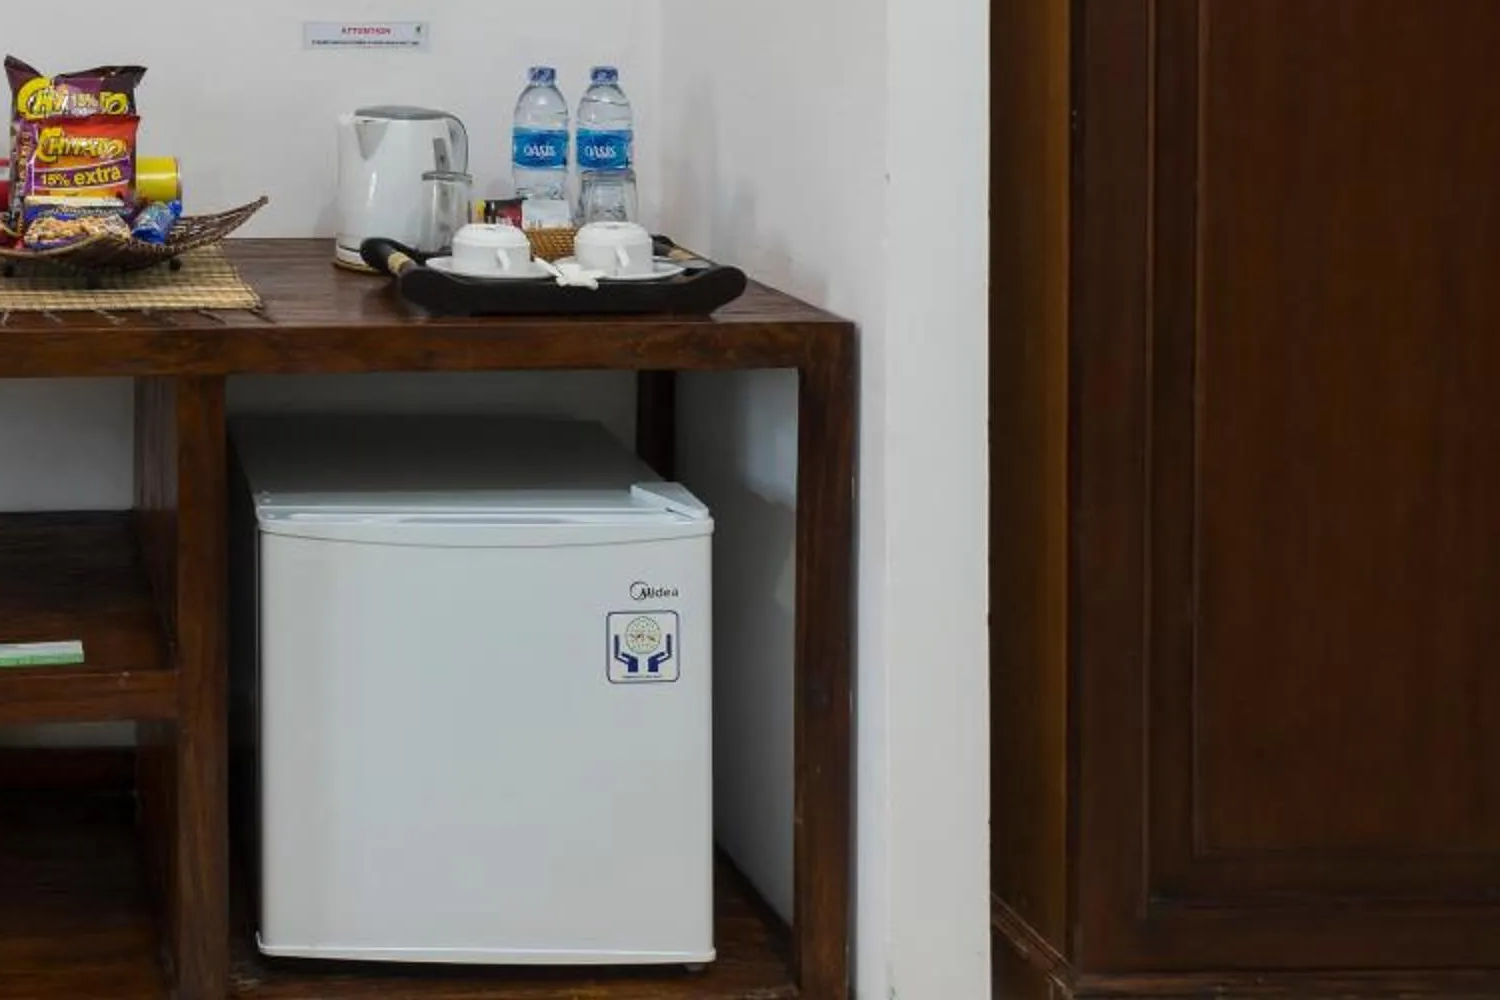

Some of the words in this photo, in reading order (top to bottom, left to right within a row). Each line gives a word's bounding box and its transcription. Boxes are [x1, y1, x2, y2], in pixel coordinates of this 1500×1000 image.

[41, 173, 70, 187] 15%
[73, 166, 122, 186] extra
[633, 583, 680, 600] Midea
